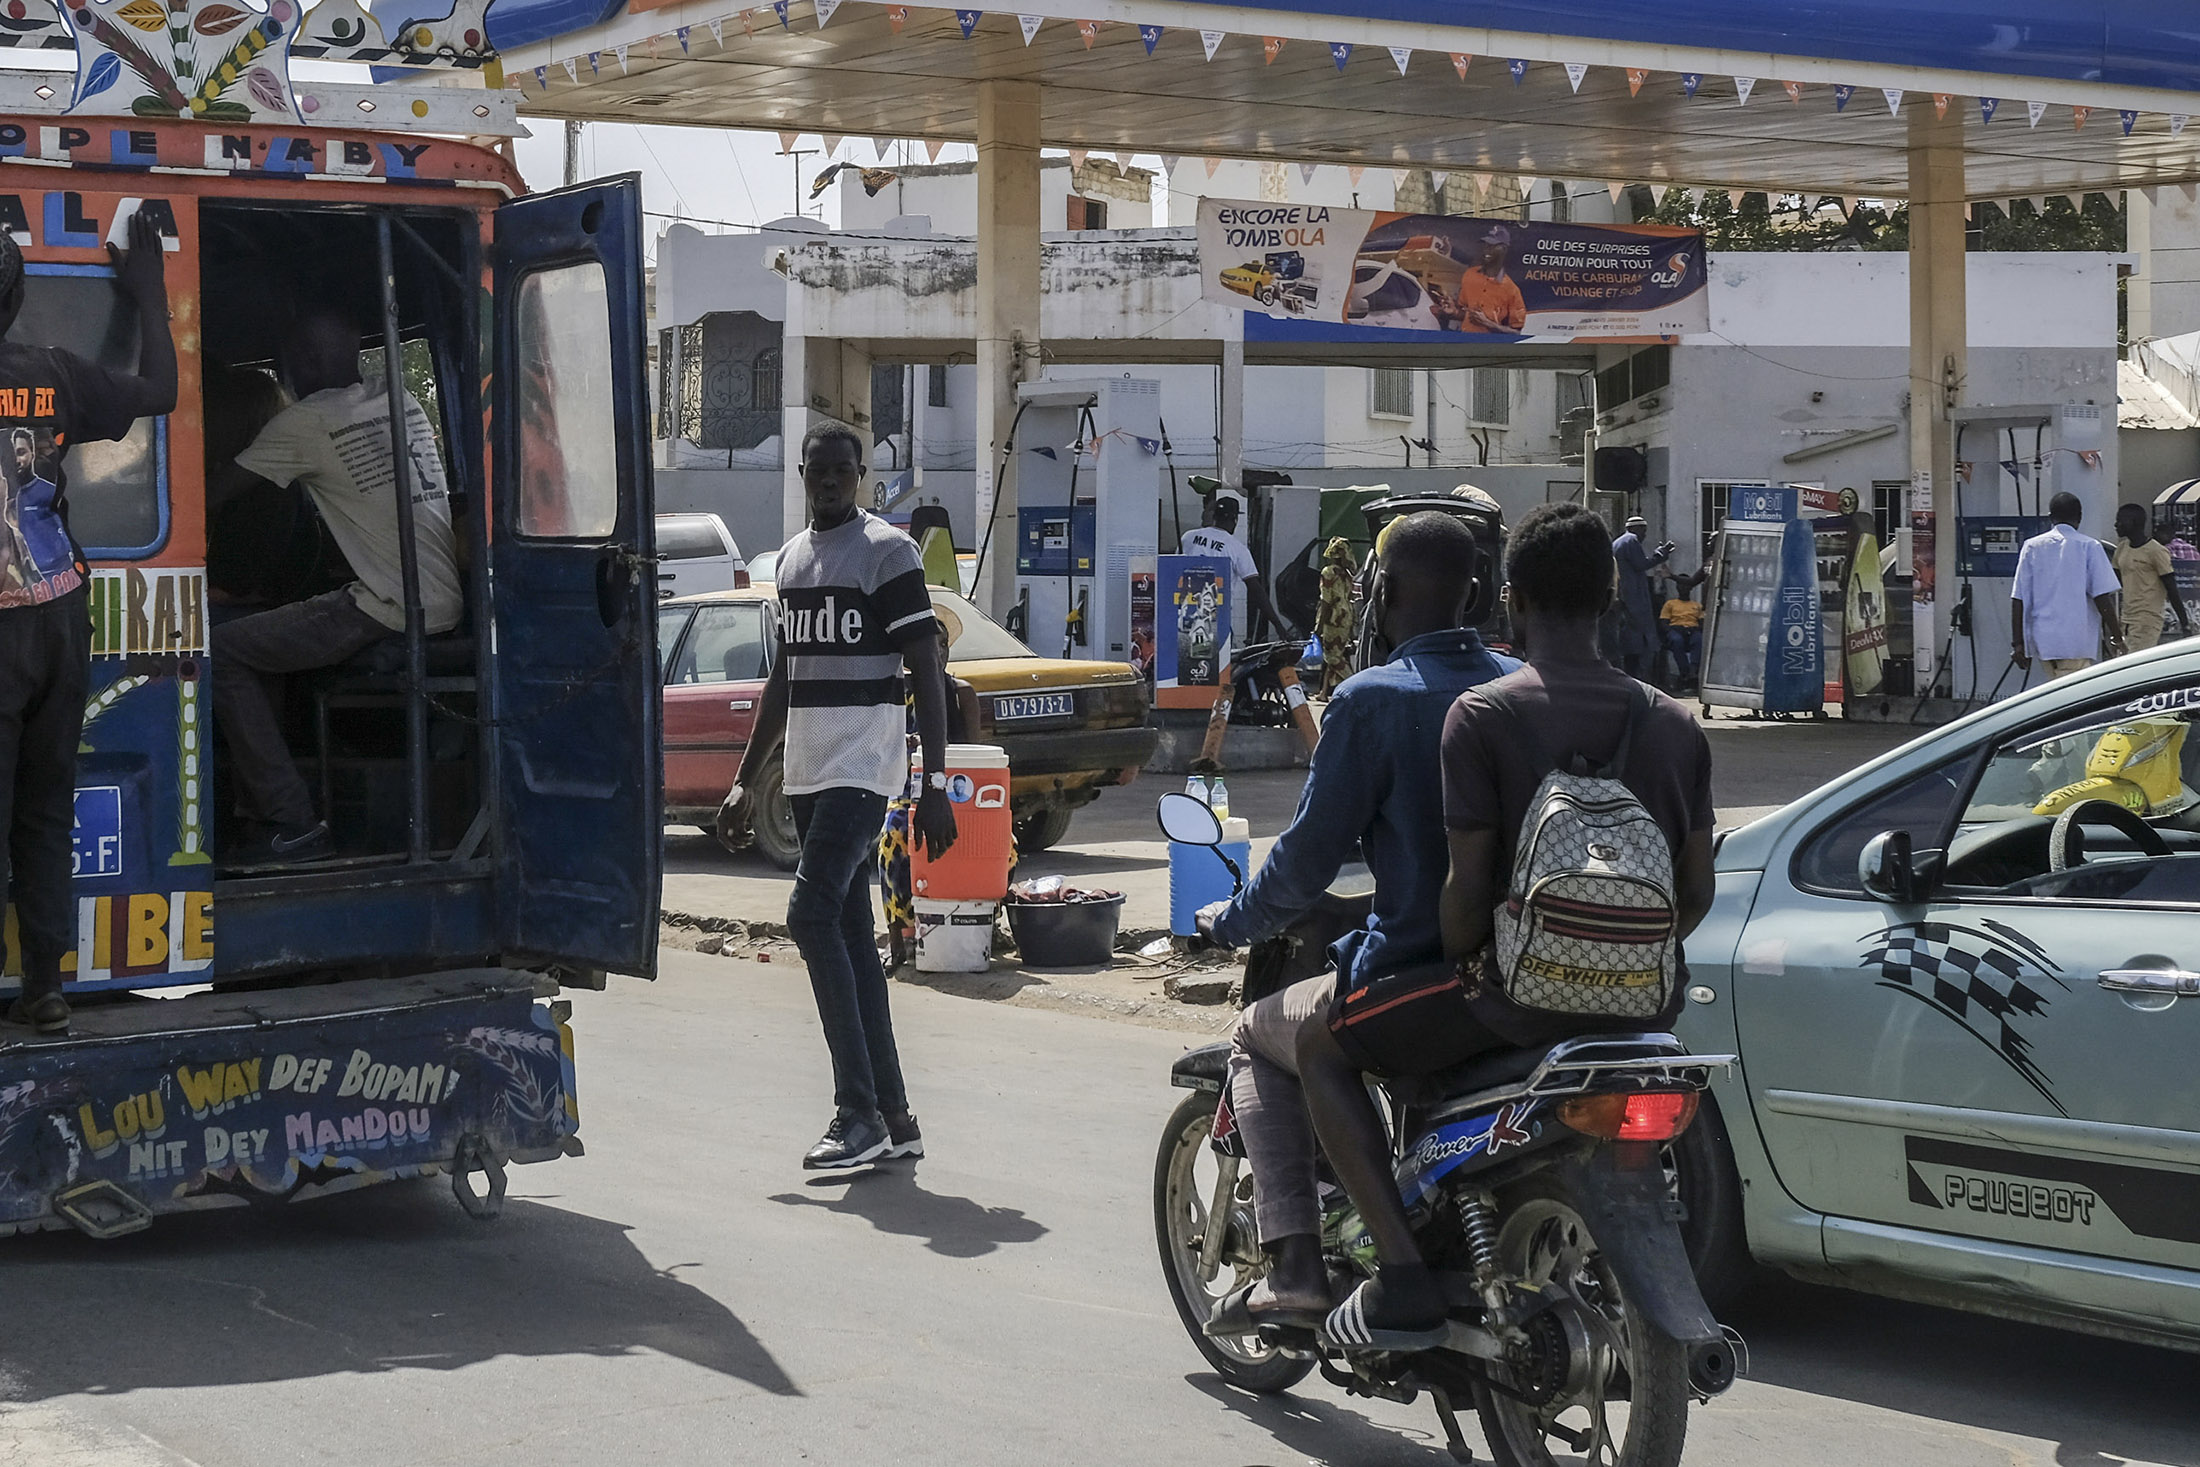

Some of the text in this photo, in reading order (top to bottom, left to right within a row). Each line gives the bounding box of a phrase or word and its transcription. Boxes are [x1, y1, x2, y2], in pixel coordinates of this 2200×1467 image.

[205, 135, 430, 178] NABY
[1218, 206, 1330, 225] ENCORE LA
[1536, 239, 1650, 256] QUE DES SURPRISES
[1522, 254, 1653, 270] EN STATION POUR TOUT
[1525, 270, 1560, 281] ACHAT
[1563, 271, 1579, 282] DE
[1651, 271, 1678, 284] OLA
[1552, 286, 1602, 298] VIDANGE
[1605, 287, 1619, 298] ET
[1743, 492, 1782, 512] Mobil
[1744, 510, 1782, 521] Lubrifiants
[1193, 535, 1225, 552] MA VIE
[777, 596, 862, 644] hude
[1804, 586, 1816, 672] Lubrifiants
[1782, 587, 1805, 675] Mobil
[1521, 957, 1627, 986] OFF-WHITE
[79, 1089, 167, 1157] LOU
[177, 1057, 262, 1116] WAY
[268, 1053, 332, 1094] DEF
[129, 1108, 431, 1178] NIT DEY MANDOU
